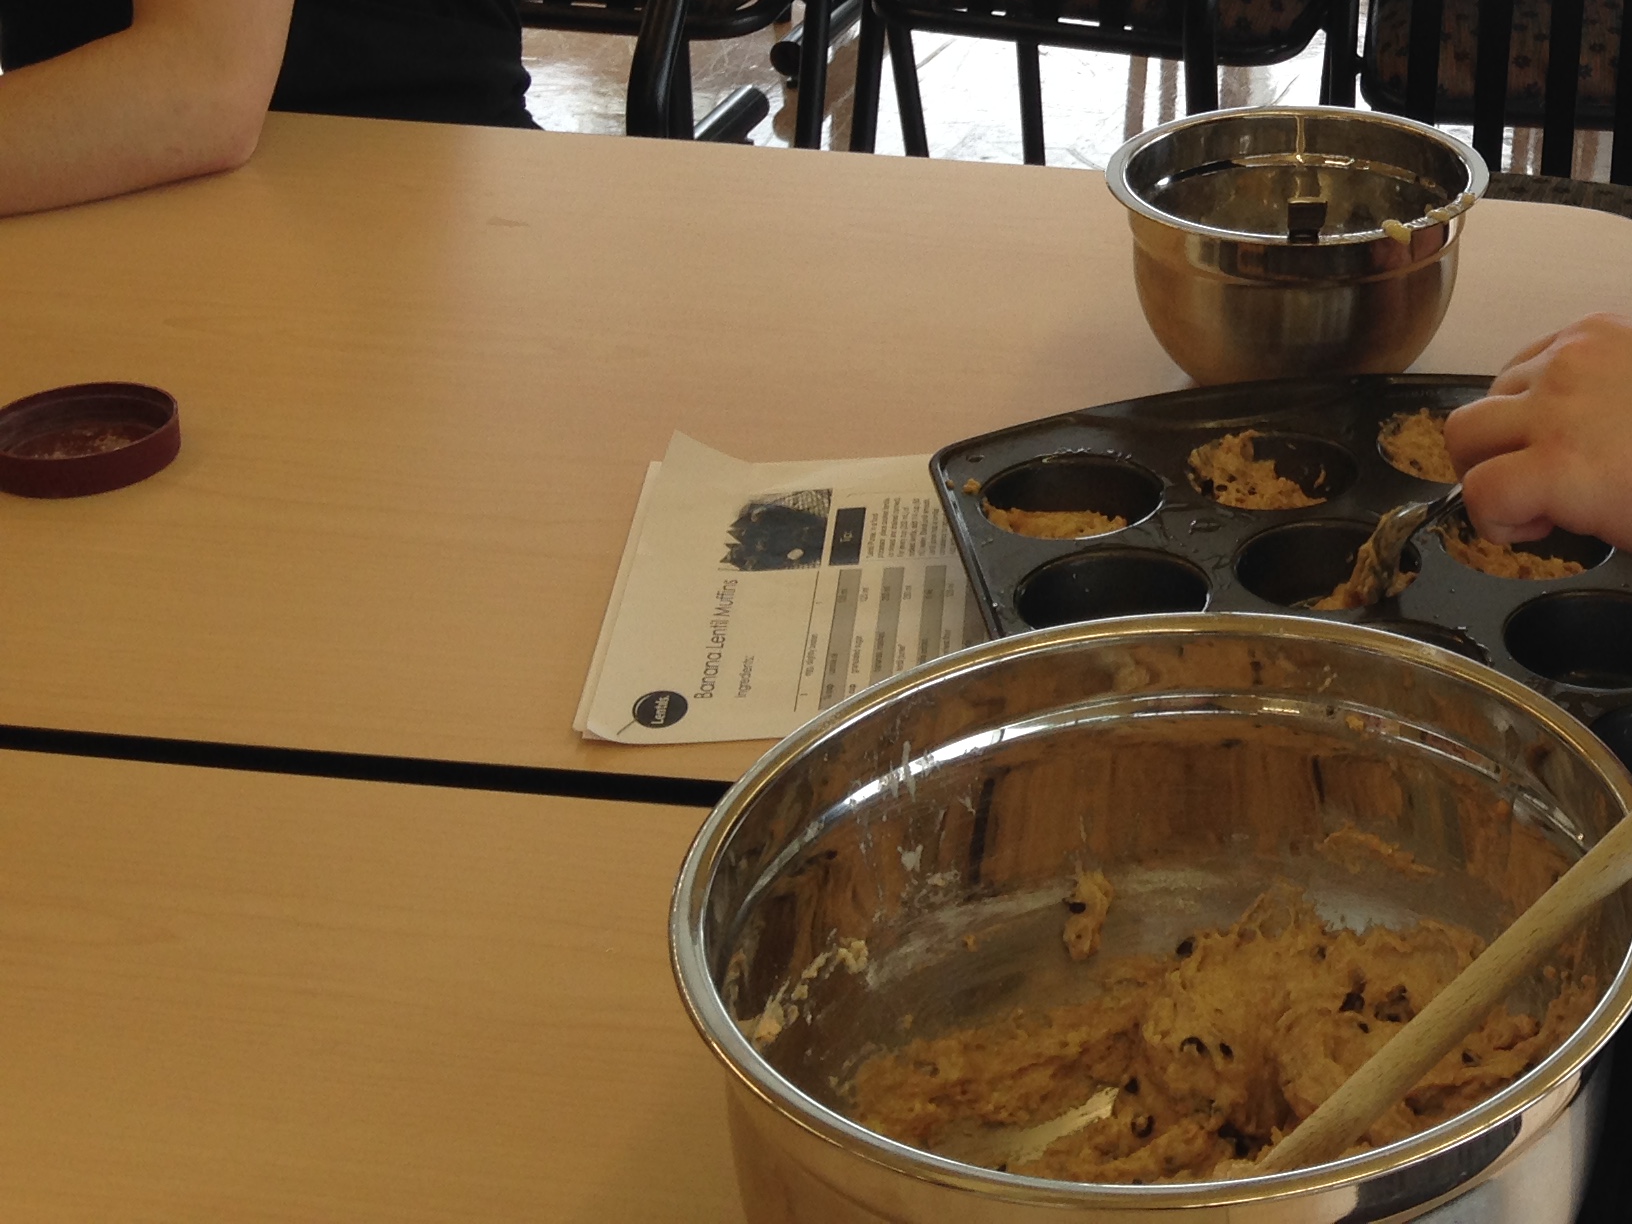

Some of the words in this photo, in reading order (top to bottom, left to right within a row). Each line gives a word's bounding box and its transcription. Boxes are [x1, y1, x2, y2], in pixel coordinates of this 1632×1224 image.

[713, 578, 739, 618] Muffins
[706, 618, 730, 650] Lentil
[693, 651, 722, 700] Banana
